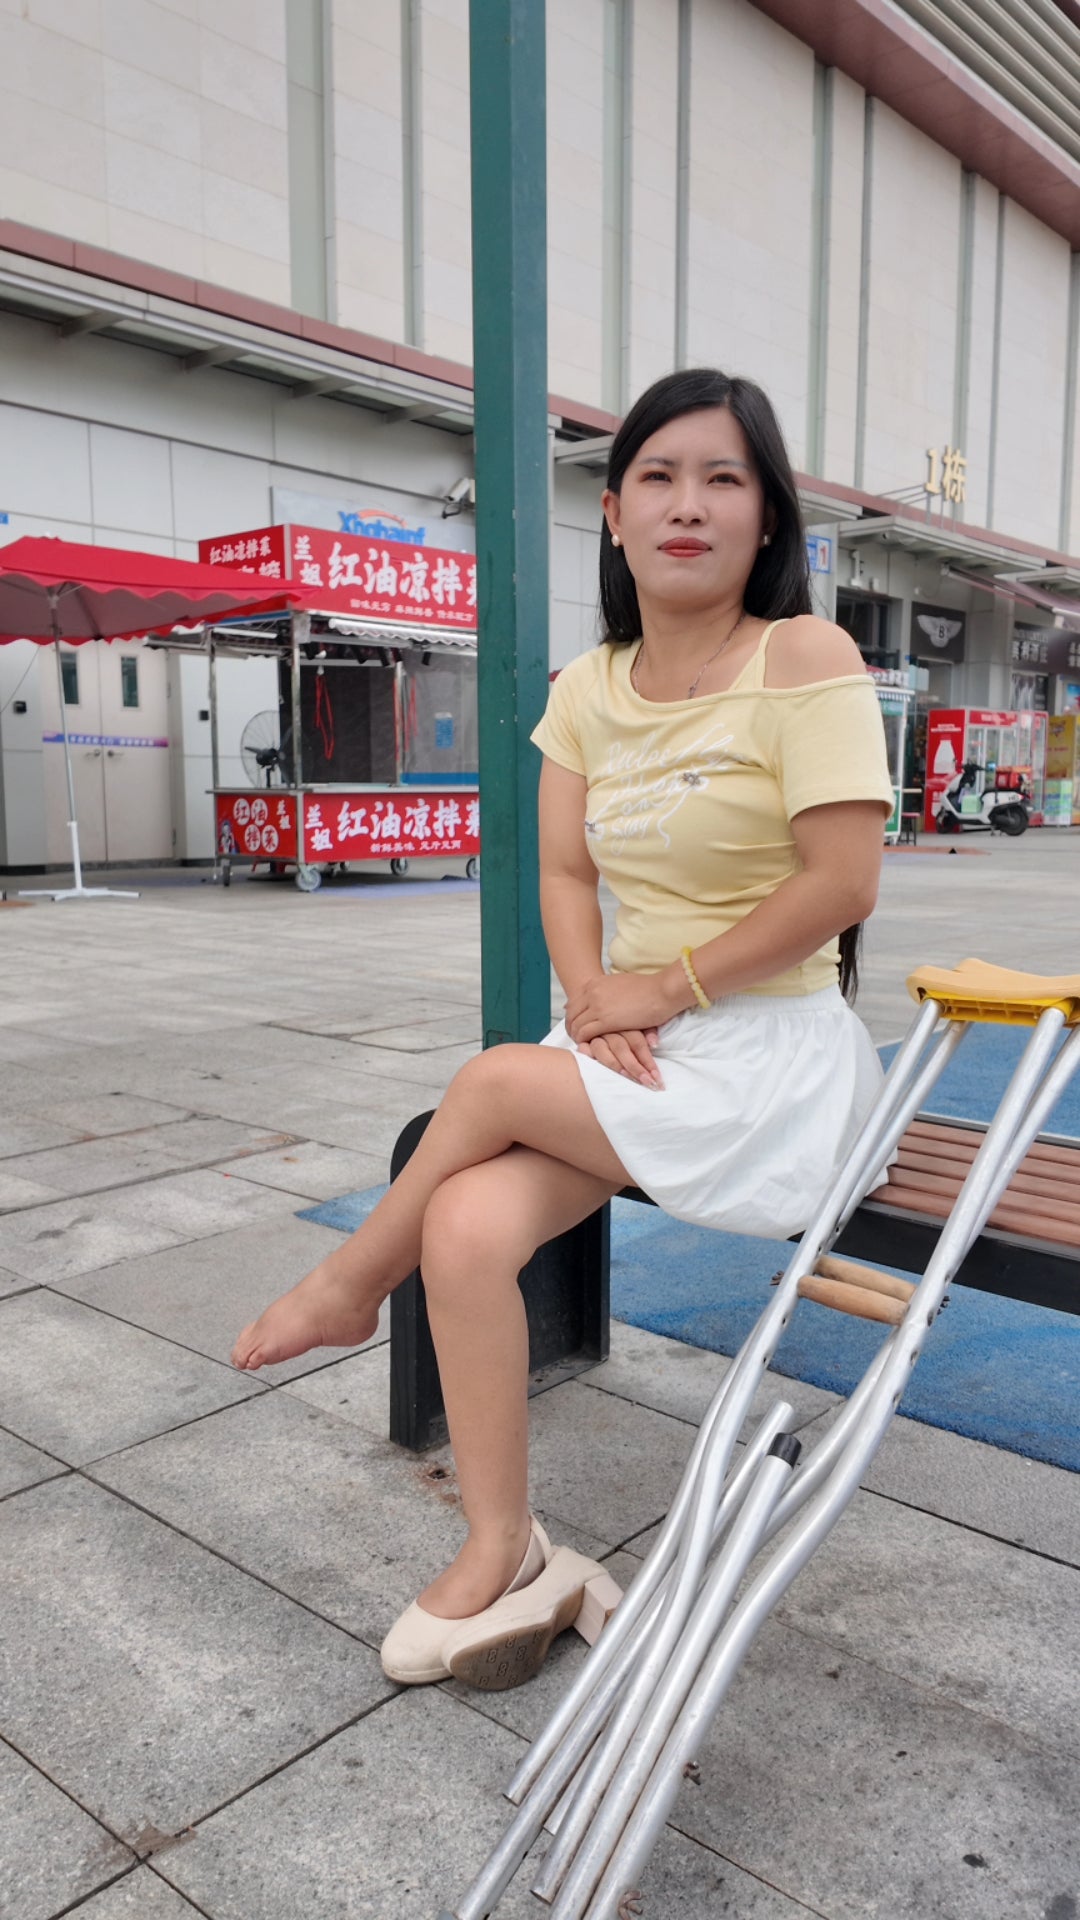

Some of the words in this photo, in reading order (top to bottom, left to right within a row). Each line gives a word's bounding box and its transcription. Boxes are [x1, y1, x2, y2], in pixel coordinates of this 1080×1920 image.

[926, 446, 967, 503] 1栋
[294, 535, 324, 587] 兰姐
[305, 804, 333, 851] 兰姐
